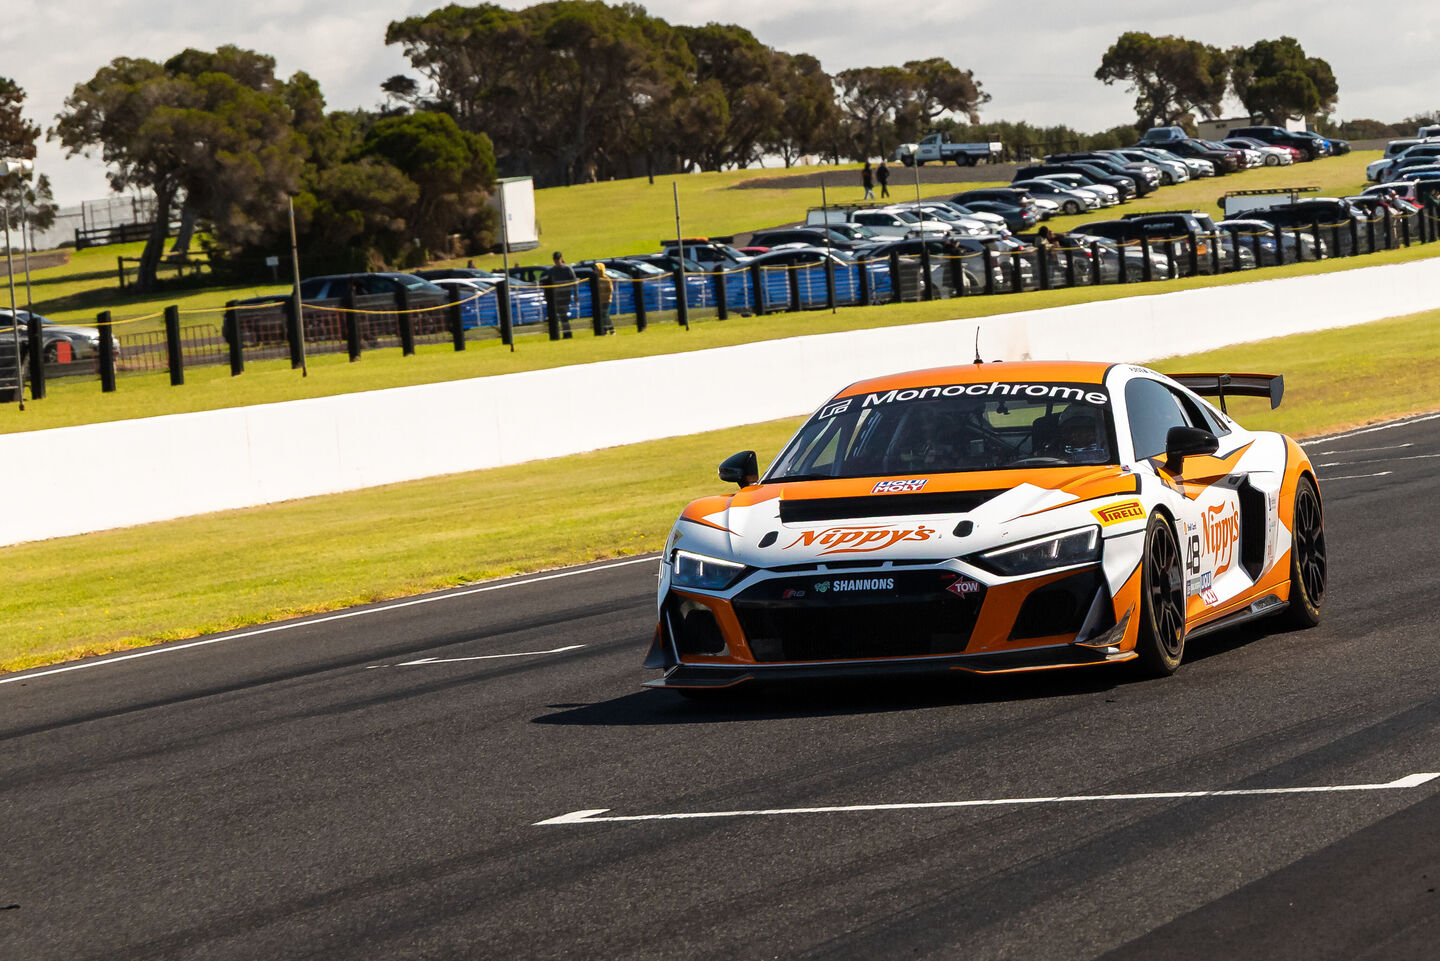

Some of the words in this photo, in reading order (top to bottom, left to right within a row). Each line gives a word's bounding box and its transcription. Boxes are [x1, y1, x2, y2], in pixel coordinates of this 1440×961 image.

[861, 382, 1107, 408] Monochrome
[874, 485, 922, 493] MOLY
[1098, 502, 1143, 523] PIRELLI
[782, 524, 936, 556] Nippy's
[1201, 500, 1239, 579] Nippy's
[1186, 535, 1200, 576] 48
[833, 578, 894, 592] SHANNONS
[955, 582, 978, 592] TOW
